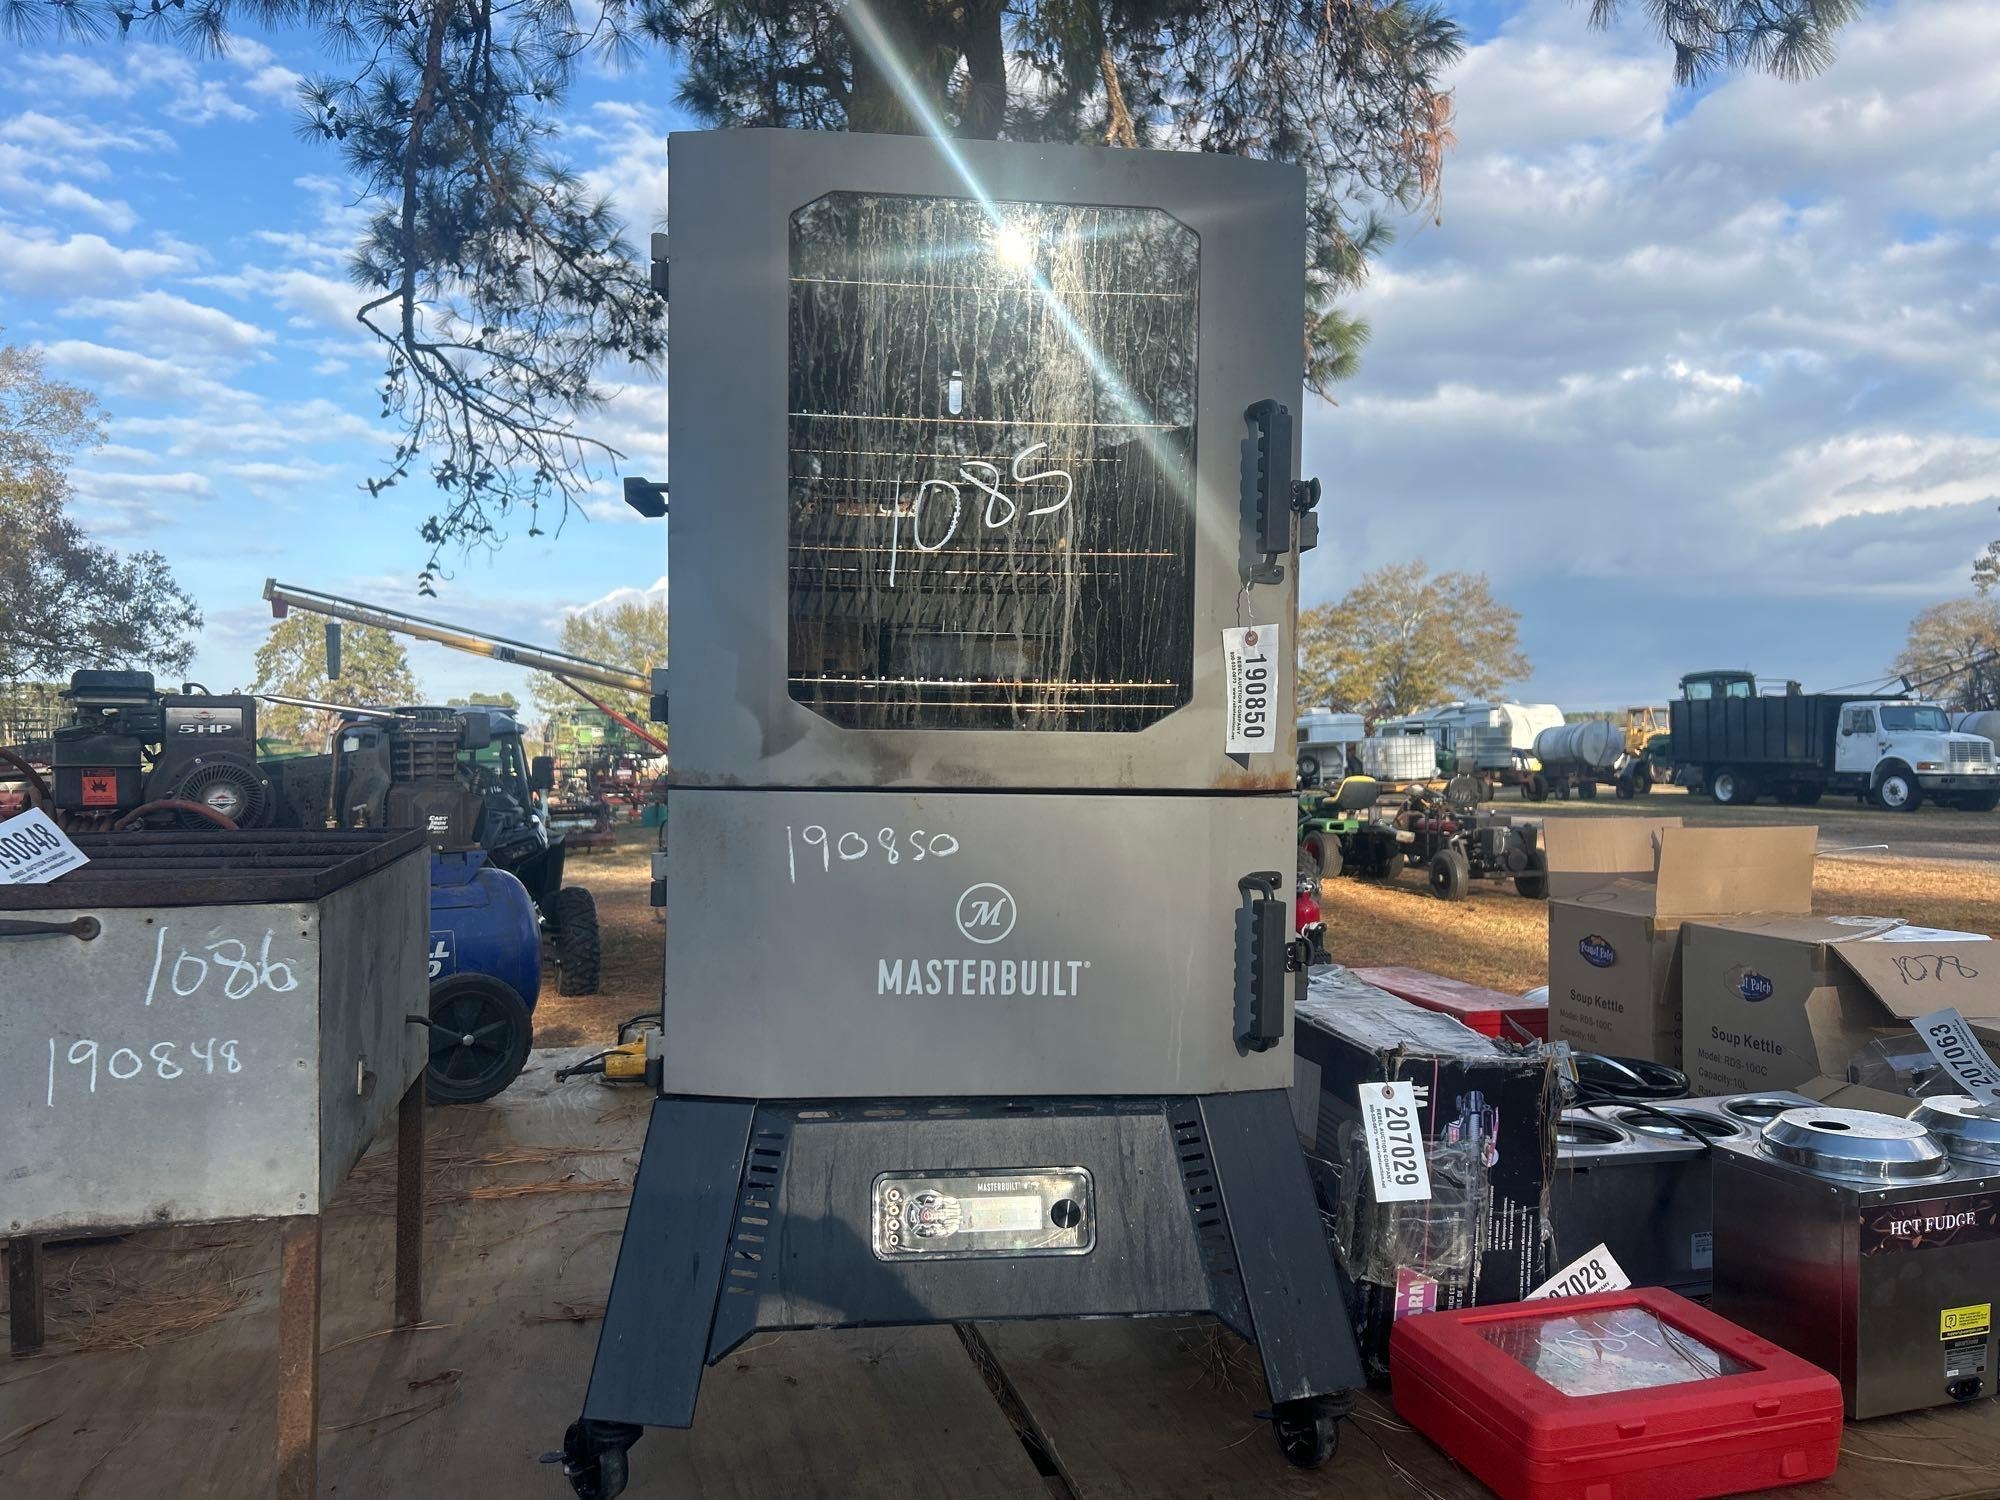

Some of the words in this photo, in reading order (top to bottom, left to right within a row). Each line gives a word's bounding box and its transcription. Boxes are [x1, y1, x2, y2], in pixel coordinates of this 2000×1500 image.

[889, 442, 1073, 588] 1085
[1243, 653, 1267, 738] 190850
[178, 724, 196, 734] 5
[197, 724, 232, 734] HP
[787, 825, 959, 883] 190850
[145, 926, 298, 1005] 1086
[878, 959, 1083, 996] MASTERBUILT
[1892, 955, 1979, 985] 1078
[1570, 988, 1593, 1007] Soup
[1595, 995, 1624, 1014] Kettle
[1750, 978, 1771, 994] Patch
[1711, 1025, 1741, 1048] Soup
[1743, 1034, 1783, 1056] Kettle
[1930, 1024, 1994, 1087] 207063
[47, 1037, 242, 1107] 190848
[1724, 1055, 1768, 1076] RDS-100C
[1385, 1106, 1420, 1186] 207029
[977, 1181, 1018, 1191] MASTERBUILT
[1384, 1154, 1392, 1182] COMPANY
[1890, 1219, 1921, 1235] HOT
[1925, 1212, 1976, 1232] FUDGE
[1541, 1259, 1607, 1299] 7028
[1408, 1281, 1425, 1316] ARN
[1535, 1321, 1661, 1369] 1084
